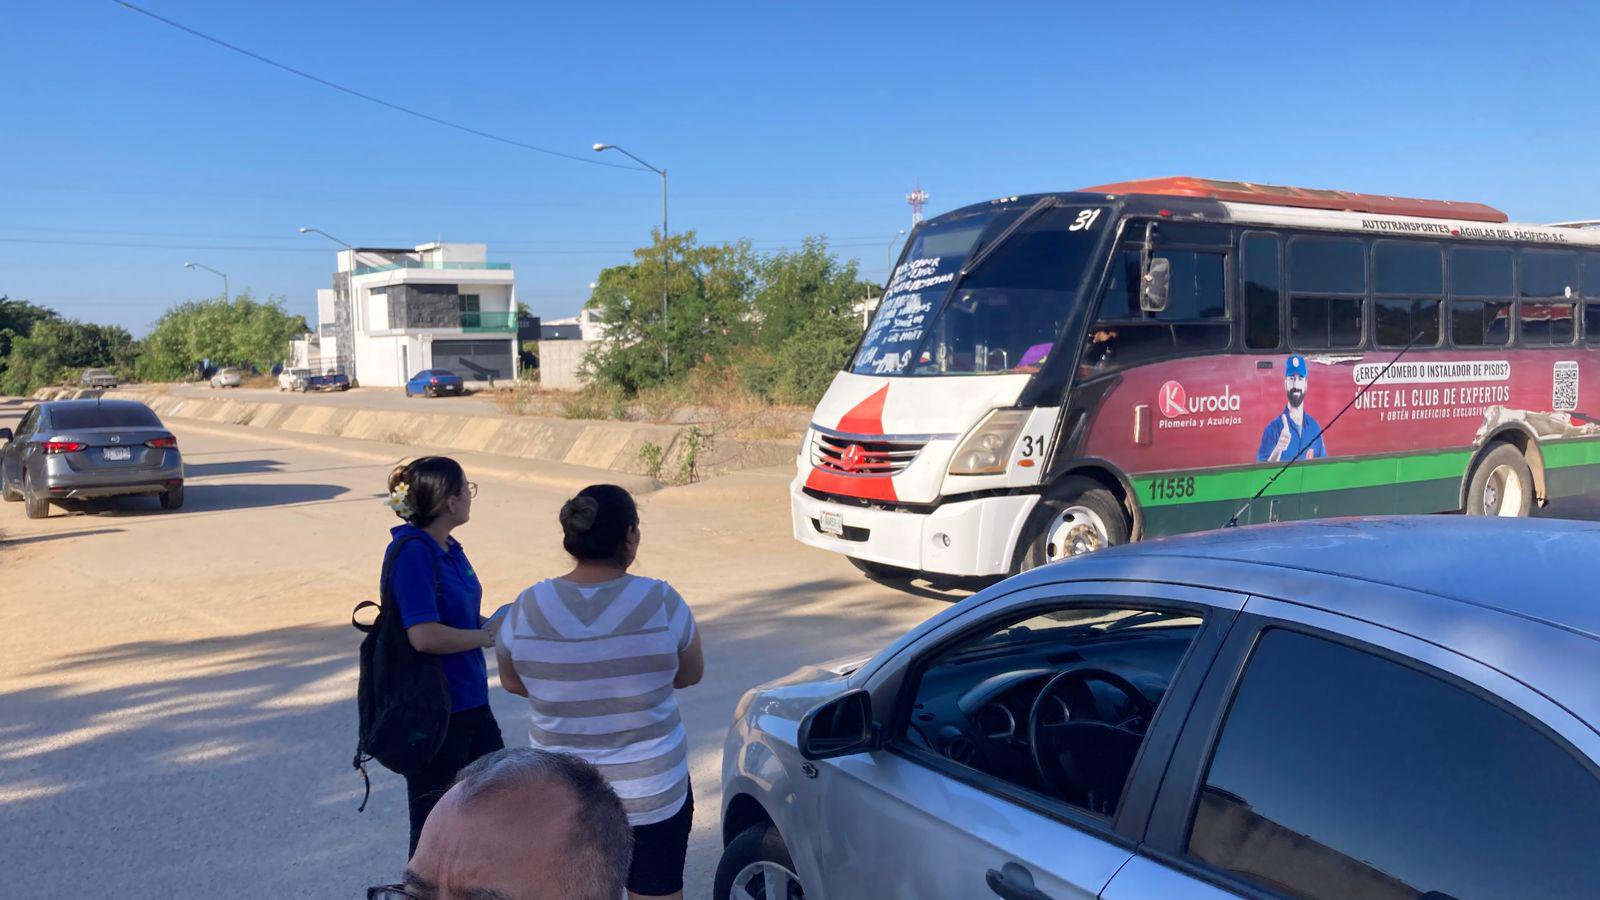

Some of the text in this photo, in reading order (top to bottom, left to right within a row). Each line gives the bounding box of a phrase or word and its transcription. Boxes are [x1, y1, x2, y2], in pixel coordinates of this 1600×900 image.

[1068, 208, 1101, 231] 31
[1362, 219, 1450, 234] AUTOTRANSPORTES
[1496, 229, 1513, 239] DEL
[1355, 363, 1508, 382] ¿ERES PLOMERO O INSTALADOR DE PISOS?
[1165, 384, 1241, 414] Kuroda
[1355, 385, 1510, 409] ÚNETE AL CLUB DE EXPERTOS
[1159, 415, 1242, 429] Plomería y Azulejos
[1380, 411, 1385, 422] Y
[1386, 407, 1409, 421] OBTÉN
[1411, 407, 1450, 420] BENEFICIOS
[1022, 434, 1046, 458] 31
[1148, 475, 1195, 500] 11558
